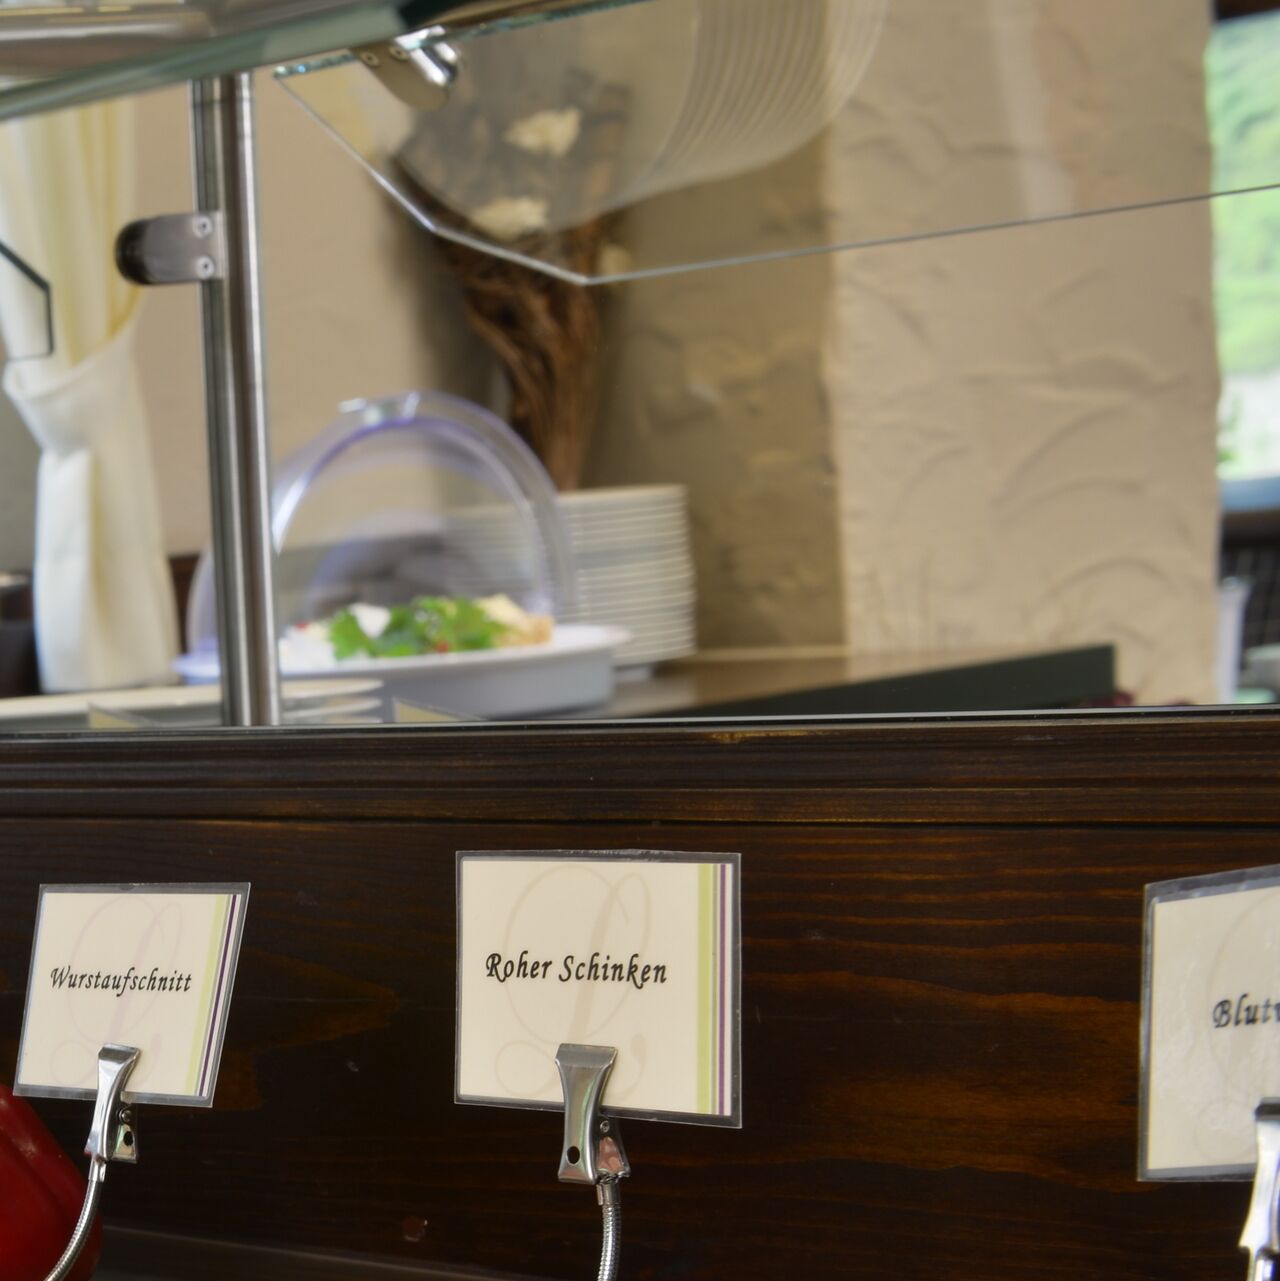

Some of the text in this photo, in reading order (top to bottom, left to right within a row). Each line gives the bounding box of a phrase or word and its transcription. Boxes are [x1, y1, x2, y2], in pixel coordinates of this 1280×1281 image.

[50, 965, 192, 998] Wurstaufschnitt
[485, 950, 668, 990] Roher Schinken
